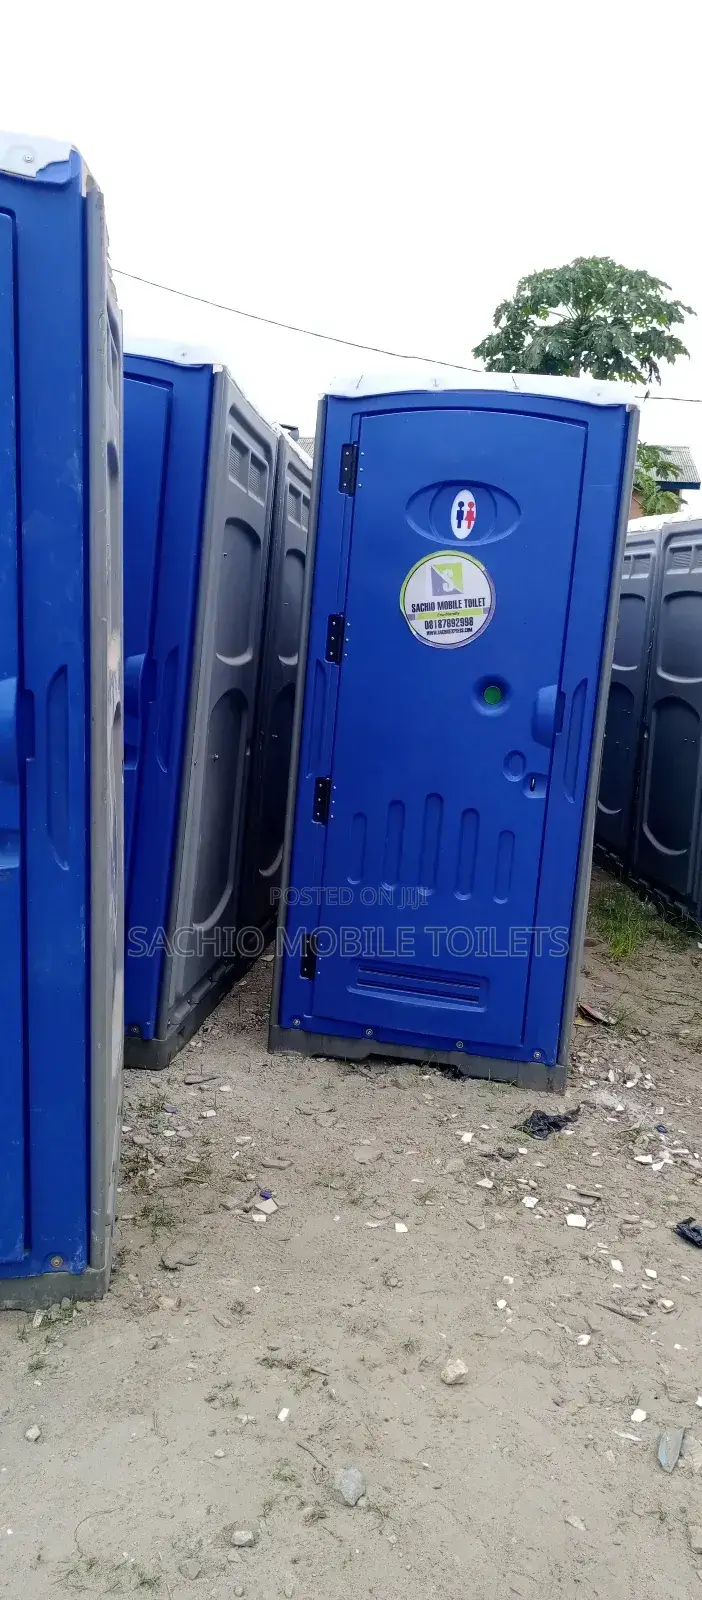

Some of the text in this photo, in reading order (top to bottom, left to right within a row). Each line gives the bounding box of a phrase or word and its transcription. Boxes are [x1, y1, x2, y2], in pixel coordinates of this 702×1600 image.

[411, 597, 486, 613] SACHIO MOBILE TOILET
